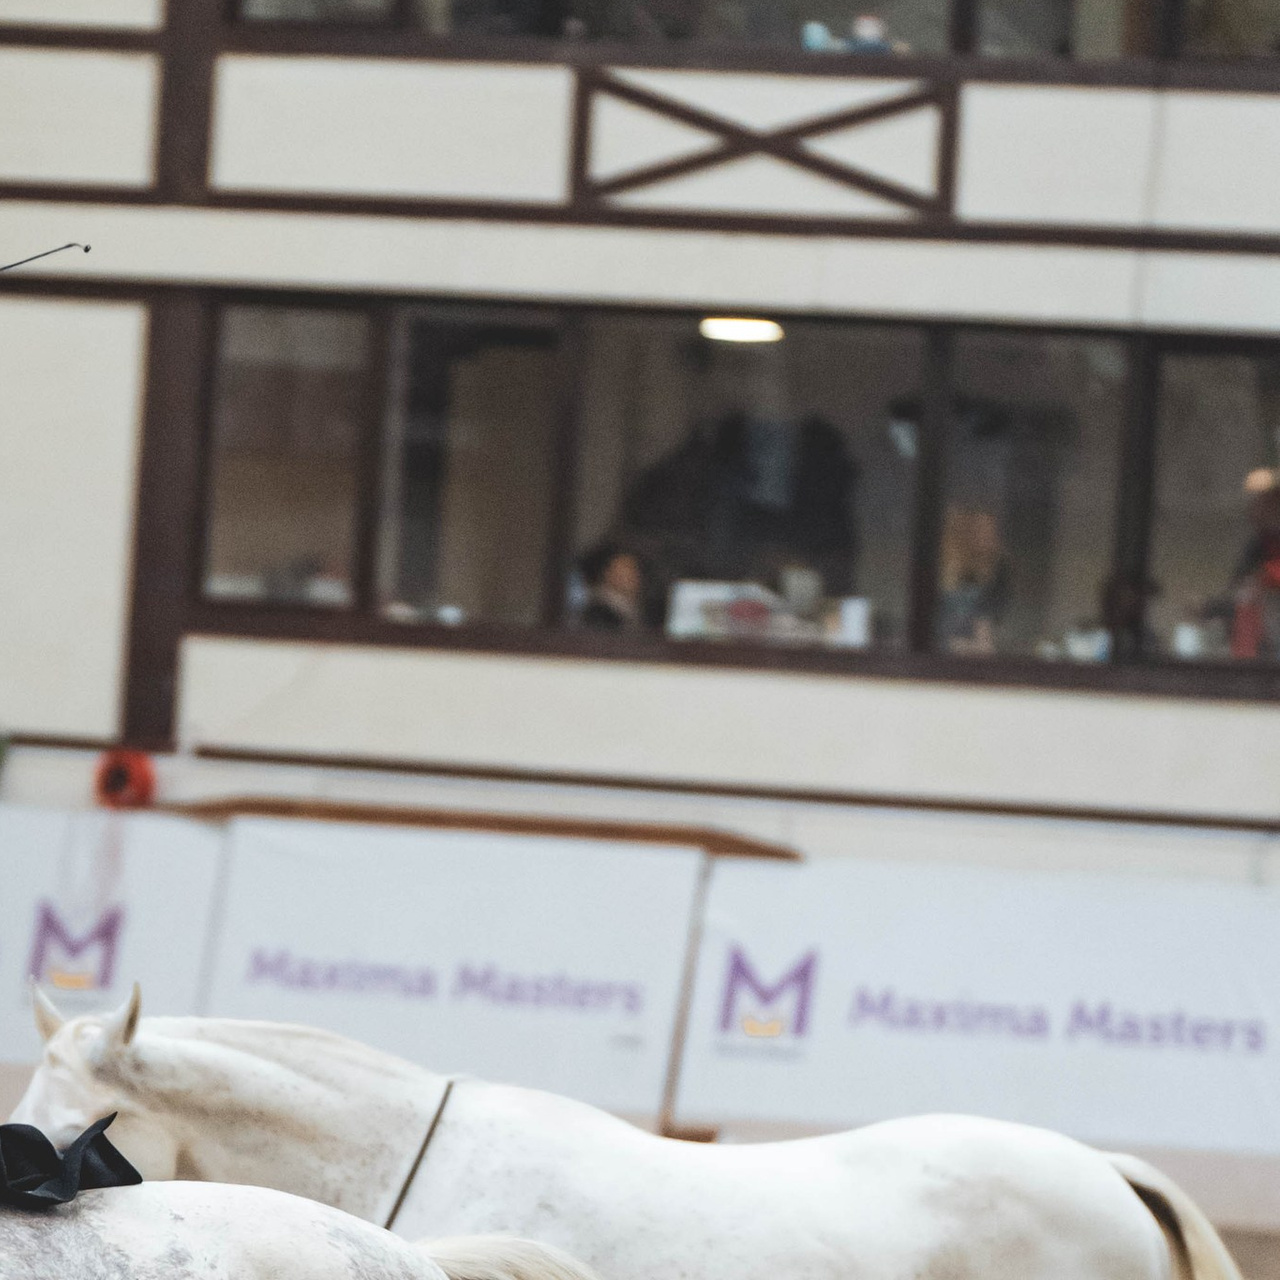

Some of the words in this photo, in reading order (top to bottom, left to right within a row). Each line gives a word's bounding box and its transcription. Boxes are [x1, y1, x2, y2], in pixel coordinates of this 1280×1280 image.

[26, 900, 124, 988] M
[247, 948, 437, 998] Maxima
[451, 963, 644, 1013] Masters
[719, 945, 818, 1035] M
[849, 986, 1051, 1041] Maxima
[1065, 1001, 1266, 1052] Masters
